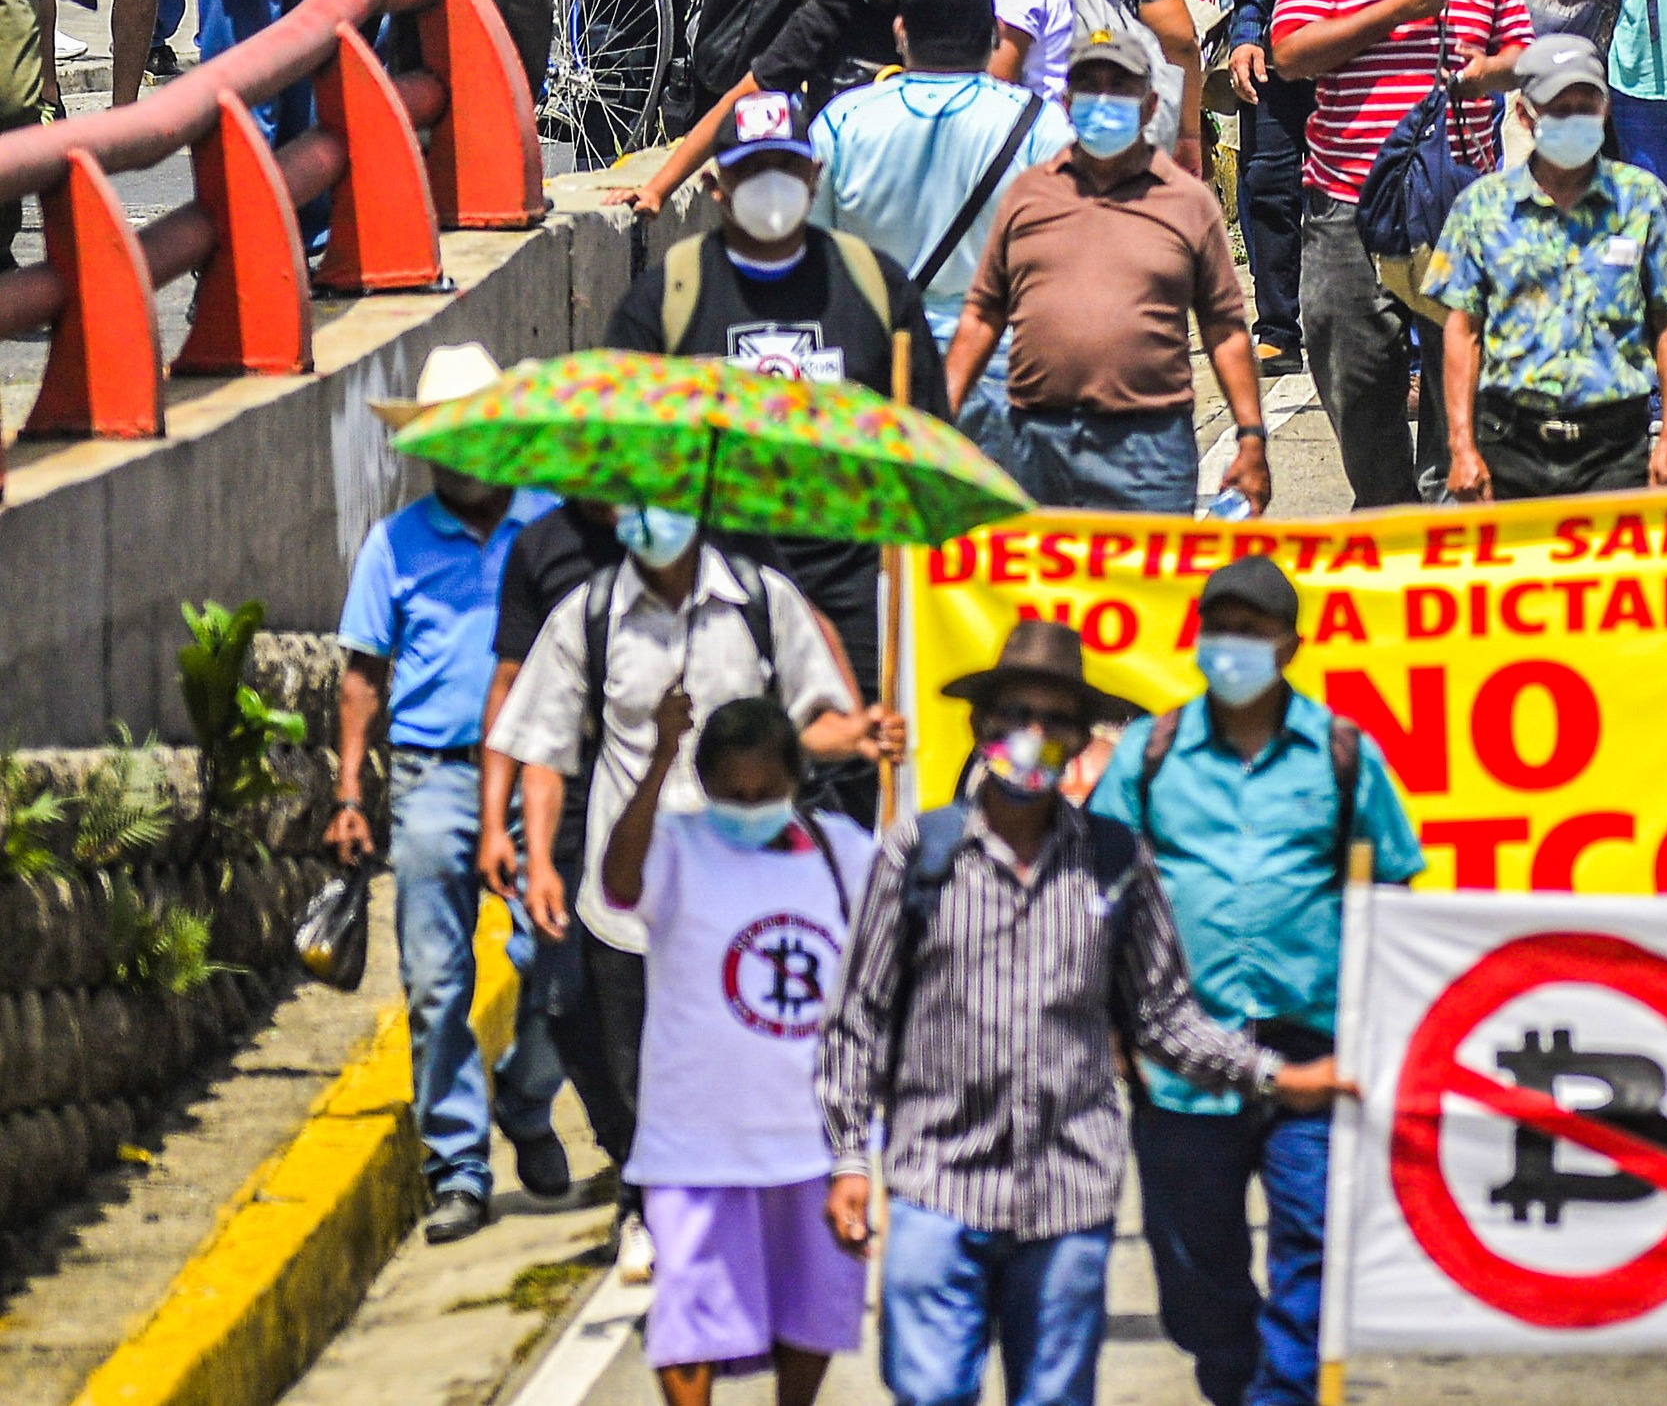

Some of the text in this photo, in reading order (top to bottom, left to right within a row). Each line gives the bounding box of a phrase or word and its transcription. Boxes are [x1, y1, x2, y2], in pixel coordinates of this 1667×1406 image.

[929, 532, 1379, 586] DESPIERTA
[1424, 524, 1496, 565] EL
[1324, 659, 1601, 795] NO
